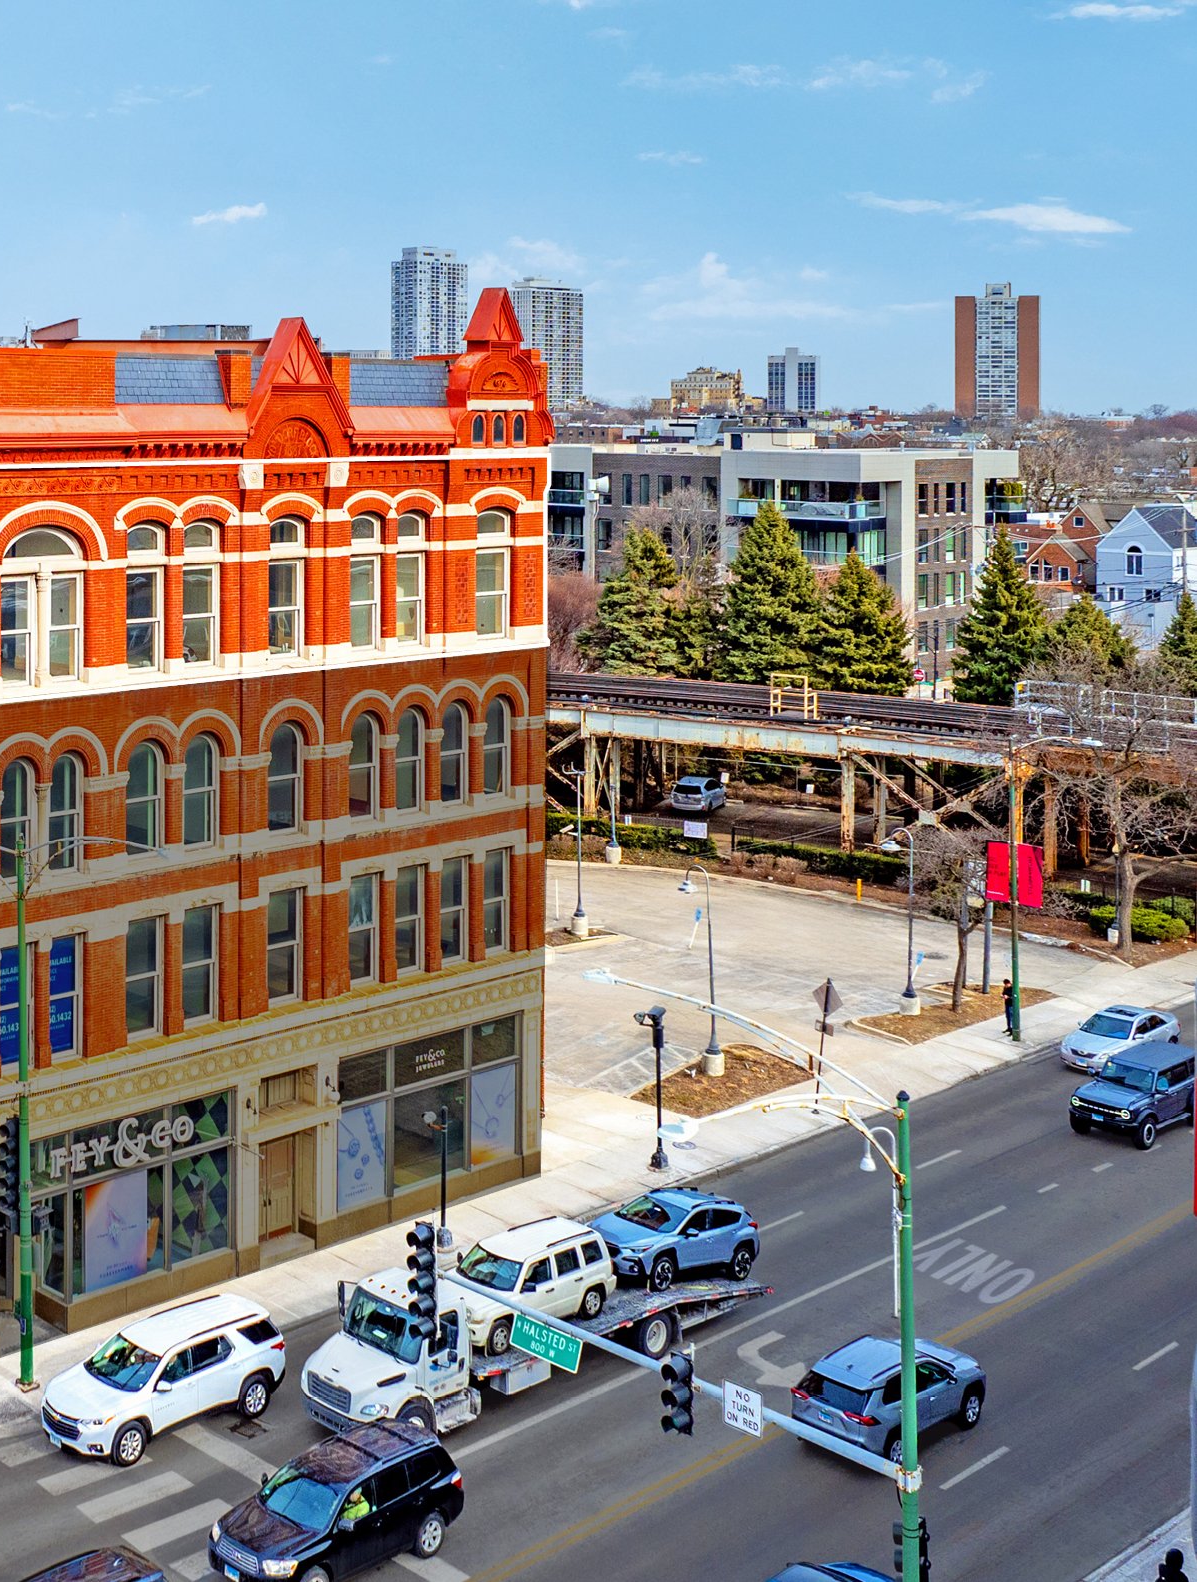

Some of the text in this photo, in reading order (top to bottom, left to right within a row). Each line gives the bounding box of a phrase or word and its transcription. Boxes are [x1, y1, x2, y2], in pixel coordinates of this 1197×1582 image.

[913, 1238, 1035, 1304] ONLY
[516, 1320, 577, 1353] N HALSTED ST
[530, 1340, 556, 1358] 800 W
[735, 1389, 750, 1402] NO
[731, 1400, 755, 1417] TURN
[726, 1411, 759, 1431] ON RED
